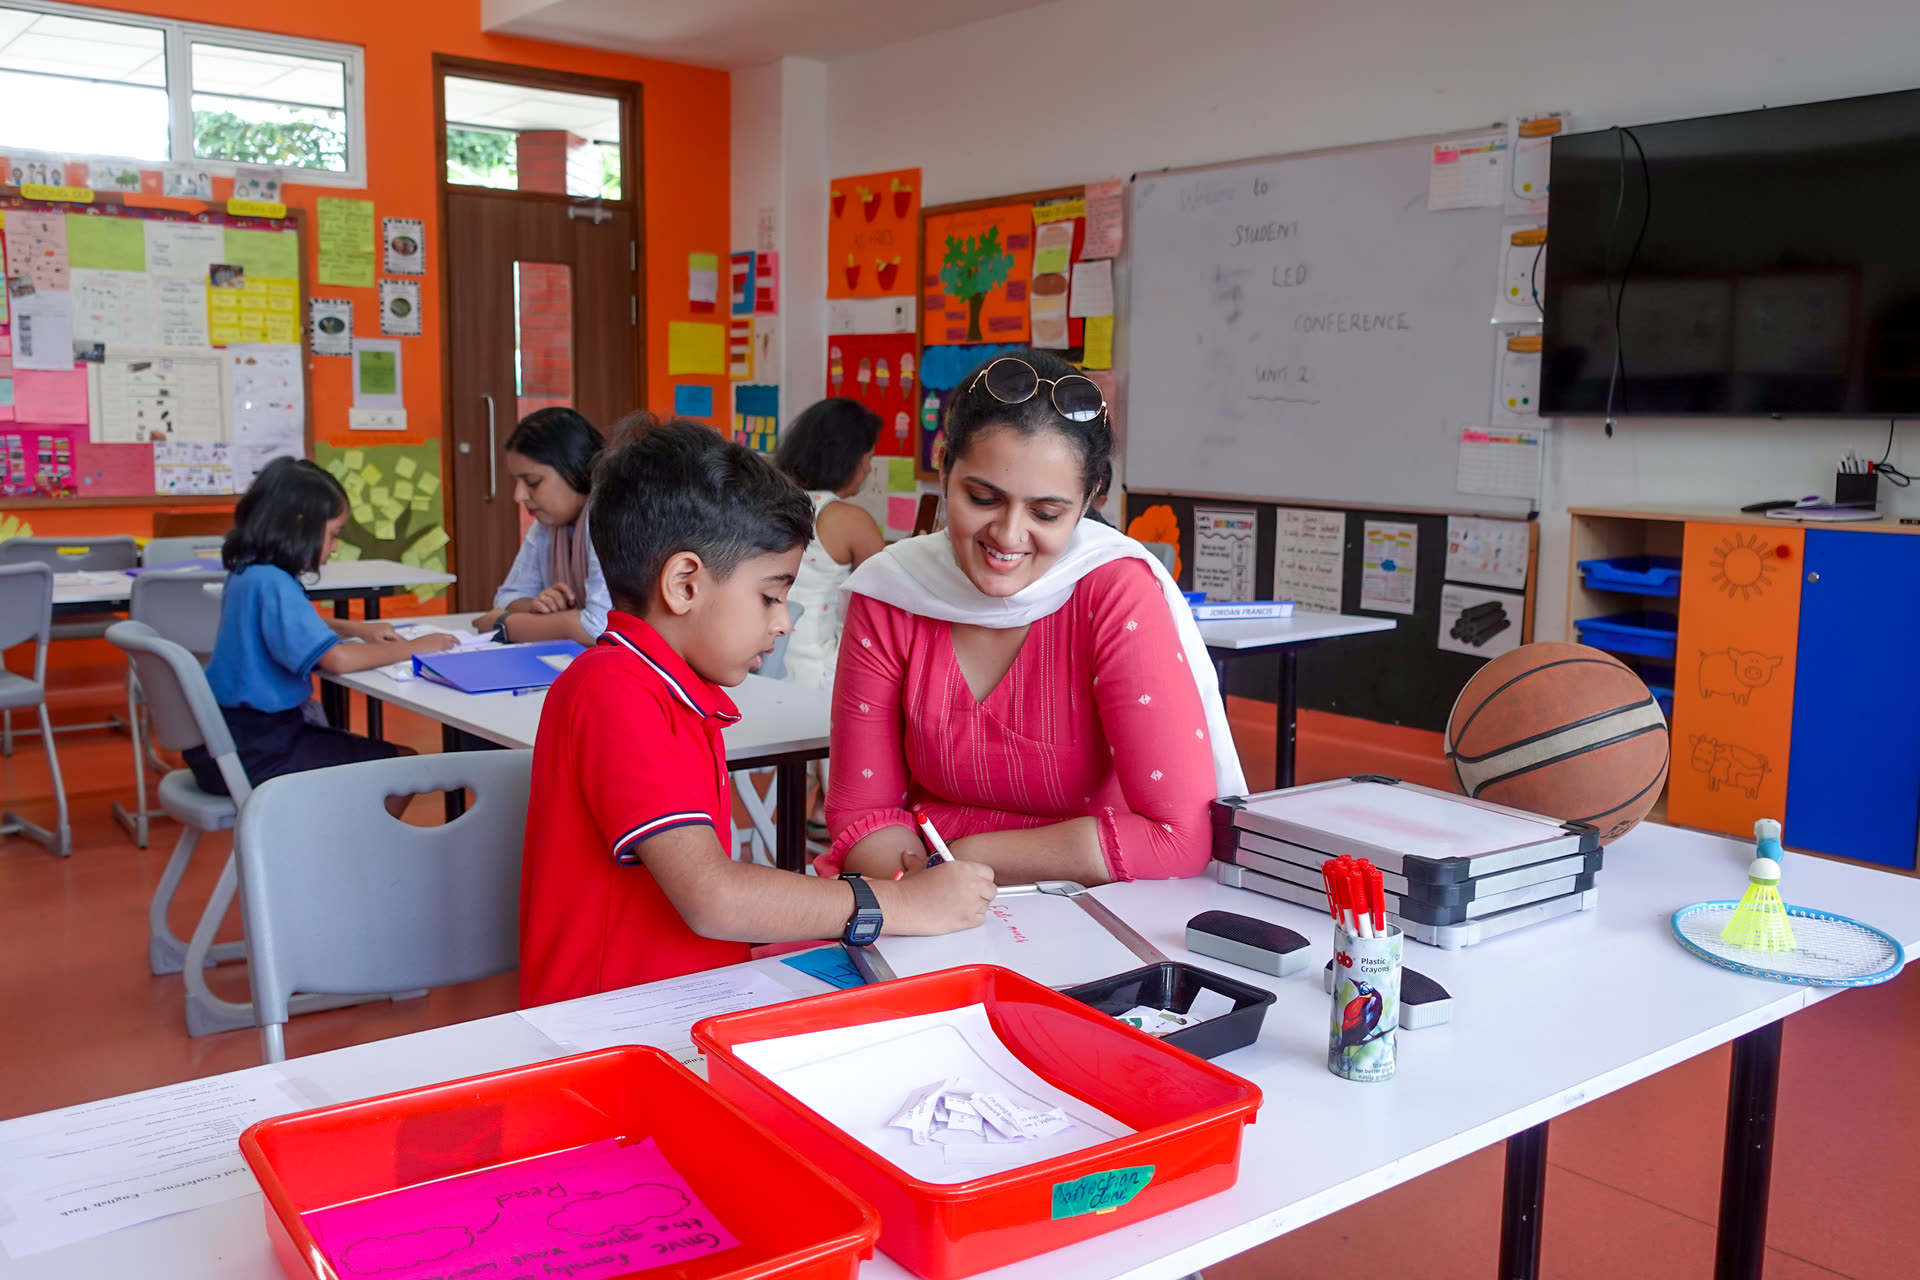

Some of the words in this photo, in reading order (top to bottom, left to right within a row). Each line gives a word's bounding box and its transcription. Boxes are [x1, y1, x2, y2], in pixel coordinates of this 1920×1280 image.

[1230, 220, 1300, 247] STUDENT
[1271, 264, 1308, 288] LED
[1294, 312, 1409, 333] CONFERENCE
[1256, 365, 1289, 383] UNIT
[1298, 365, 1310, 383] 2
[1209, 609, 1240, 617] JORDAN
[1241, 608, 1273, 616] FRANCIS
[1361, 957, 1386, 965] Plastic
[1361, 966, 1389, 974] Crayons
[153, 1174, 221, 1193] Conference
[93, 1193, 140, 1209] English
[492, 1182, 568, 1208] Read
[59, 1206, 88, 1218] Task
[655, 1217, 704, 1232] the
[579, 1228, 644, 1249] given
[651, 1233, 720, 1254] Give
[542, 1252, 630, 1277] family
